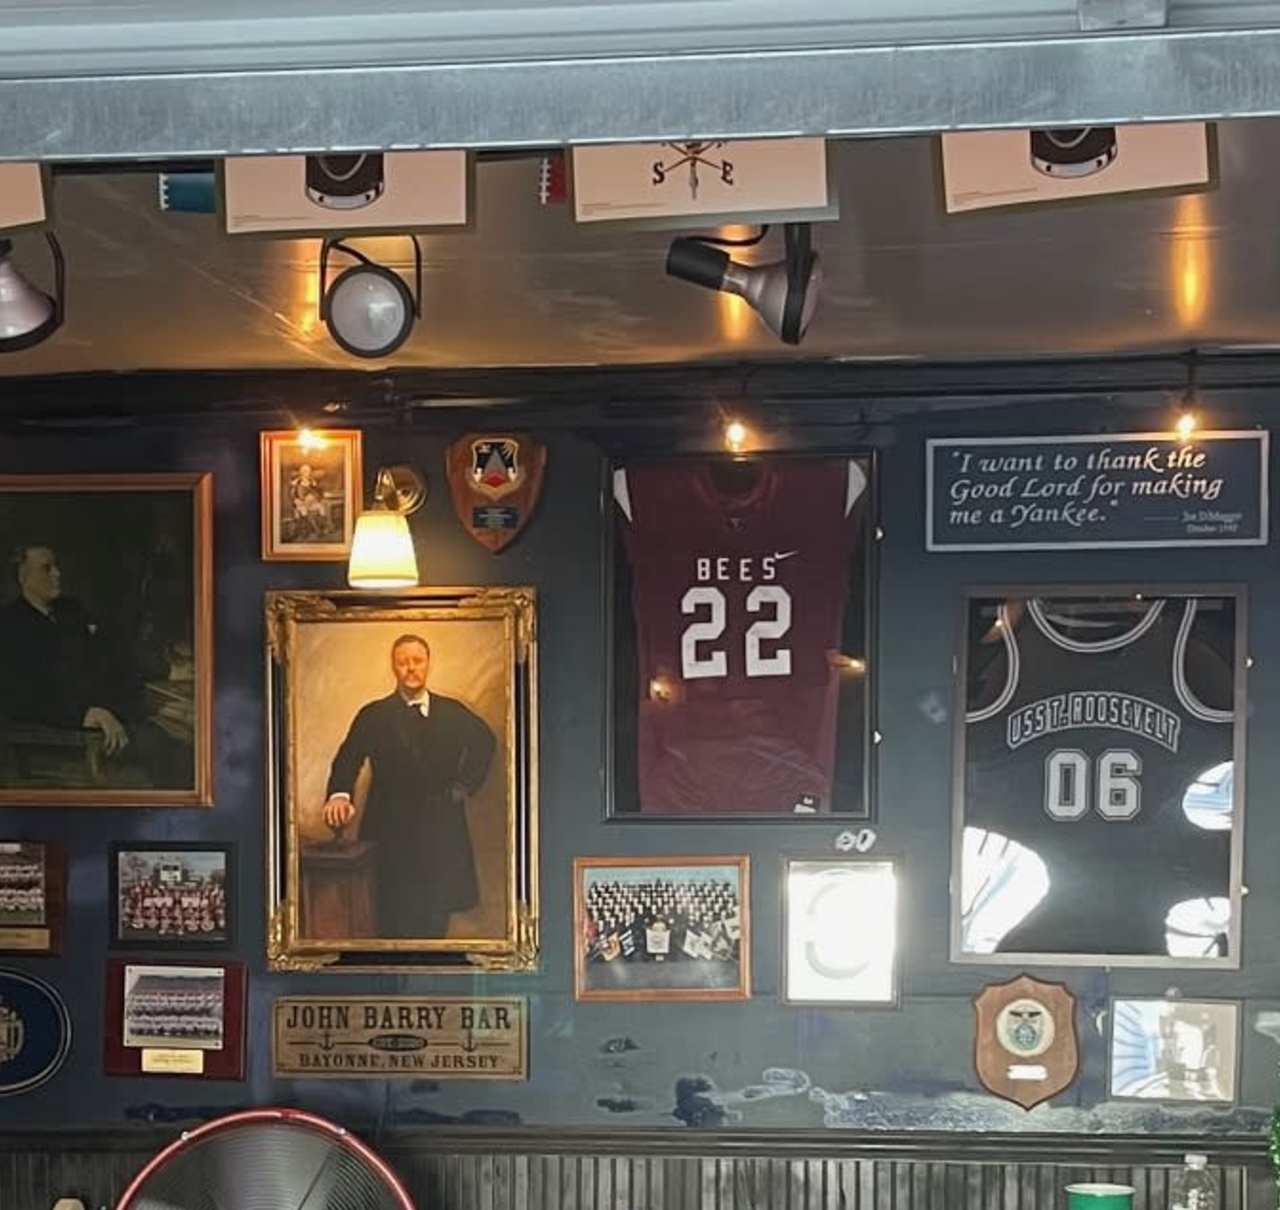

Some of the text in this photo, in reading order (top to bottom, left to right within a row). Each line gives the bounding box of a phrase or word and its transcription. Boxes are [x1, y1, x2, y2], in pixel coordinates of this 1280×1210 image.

[978, 453, 1044, 473] want
[1053, 454, 1078, 472] to
[1086, 446, 1166, 474] thank
[1166, 445, 1206, 471] the
[950, 472, 1224, 506] Good Lord for making
[948, 507, 982, 525] me
[989, 508, 1005, 524] a
[696, 557, 777, 581] BEES
[680, 584, 793, 680] 22
[1069, 692, 1180, 751] ROOSEVELT
[1044, 748, 1143, 822] 06
[286, 1006, 512, 1030] JOHN BARRY BAR
[391, 1053, 425, 1068] NEW
[430, 1053, 498, 1069] JERSEY
